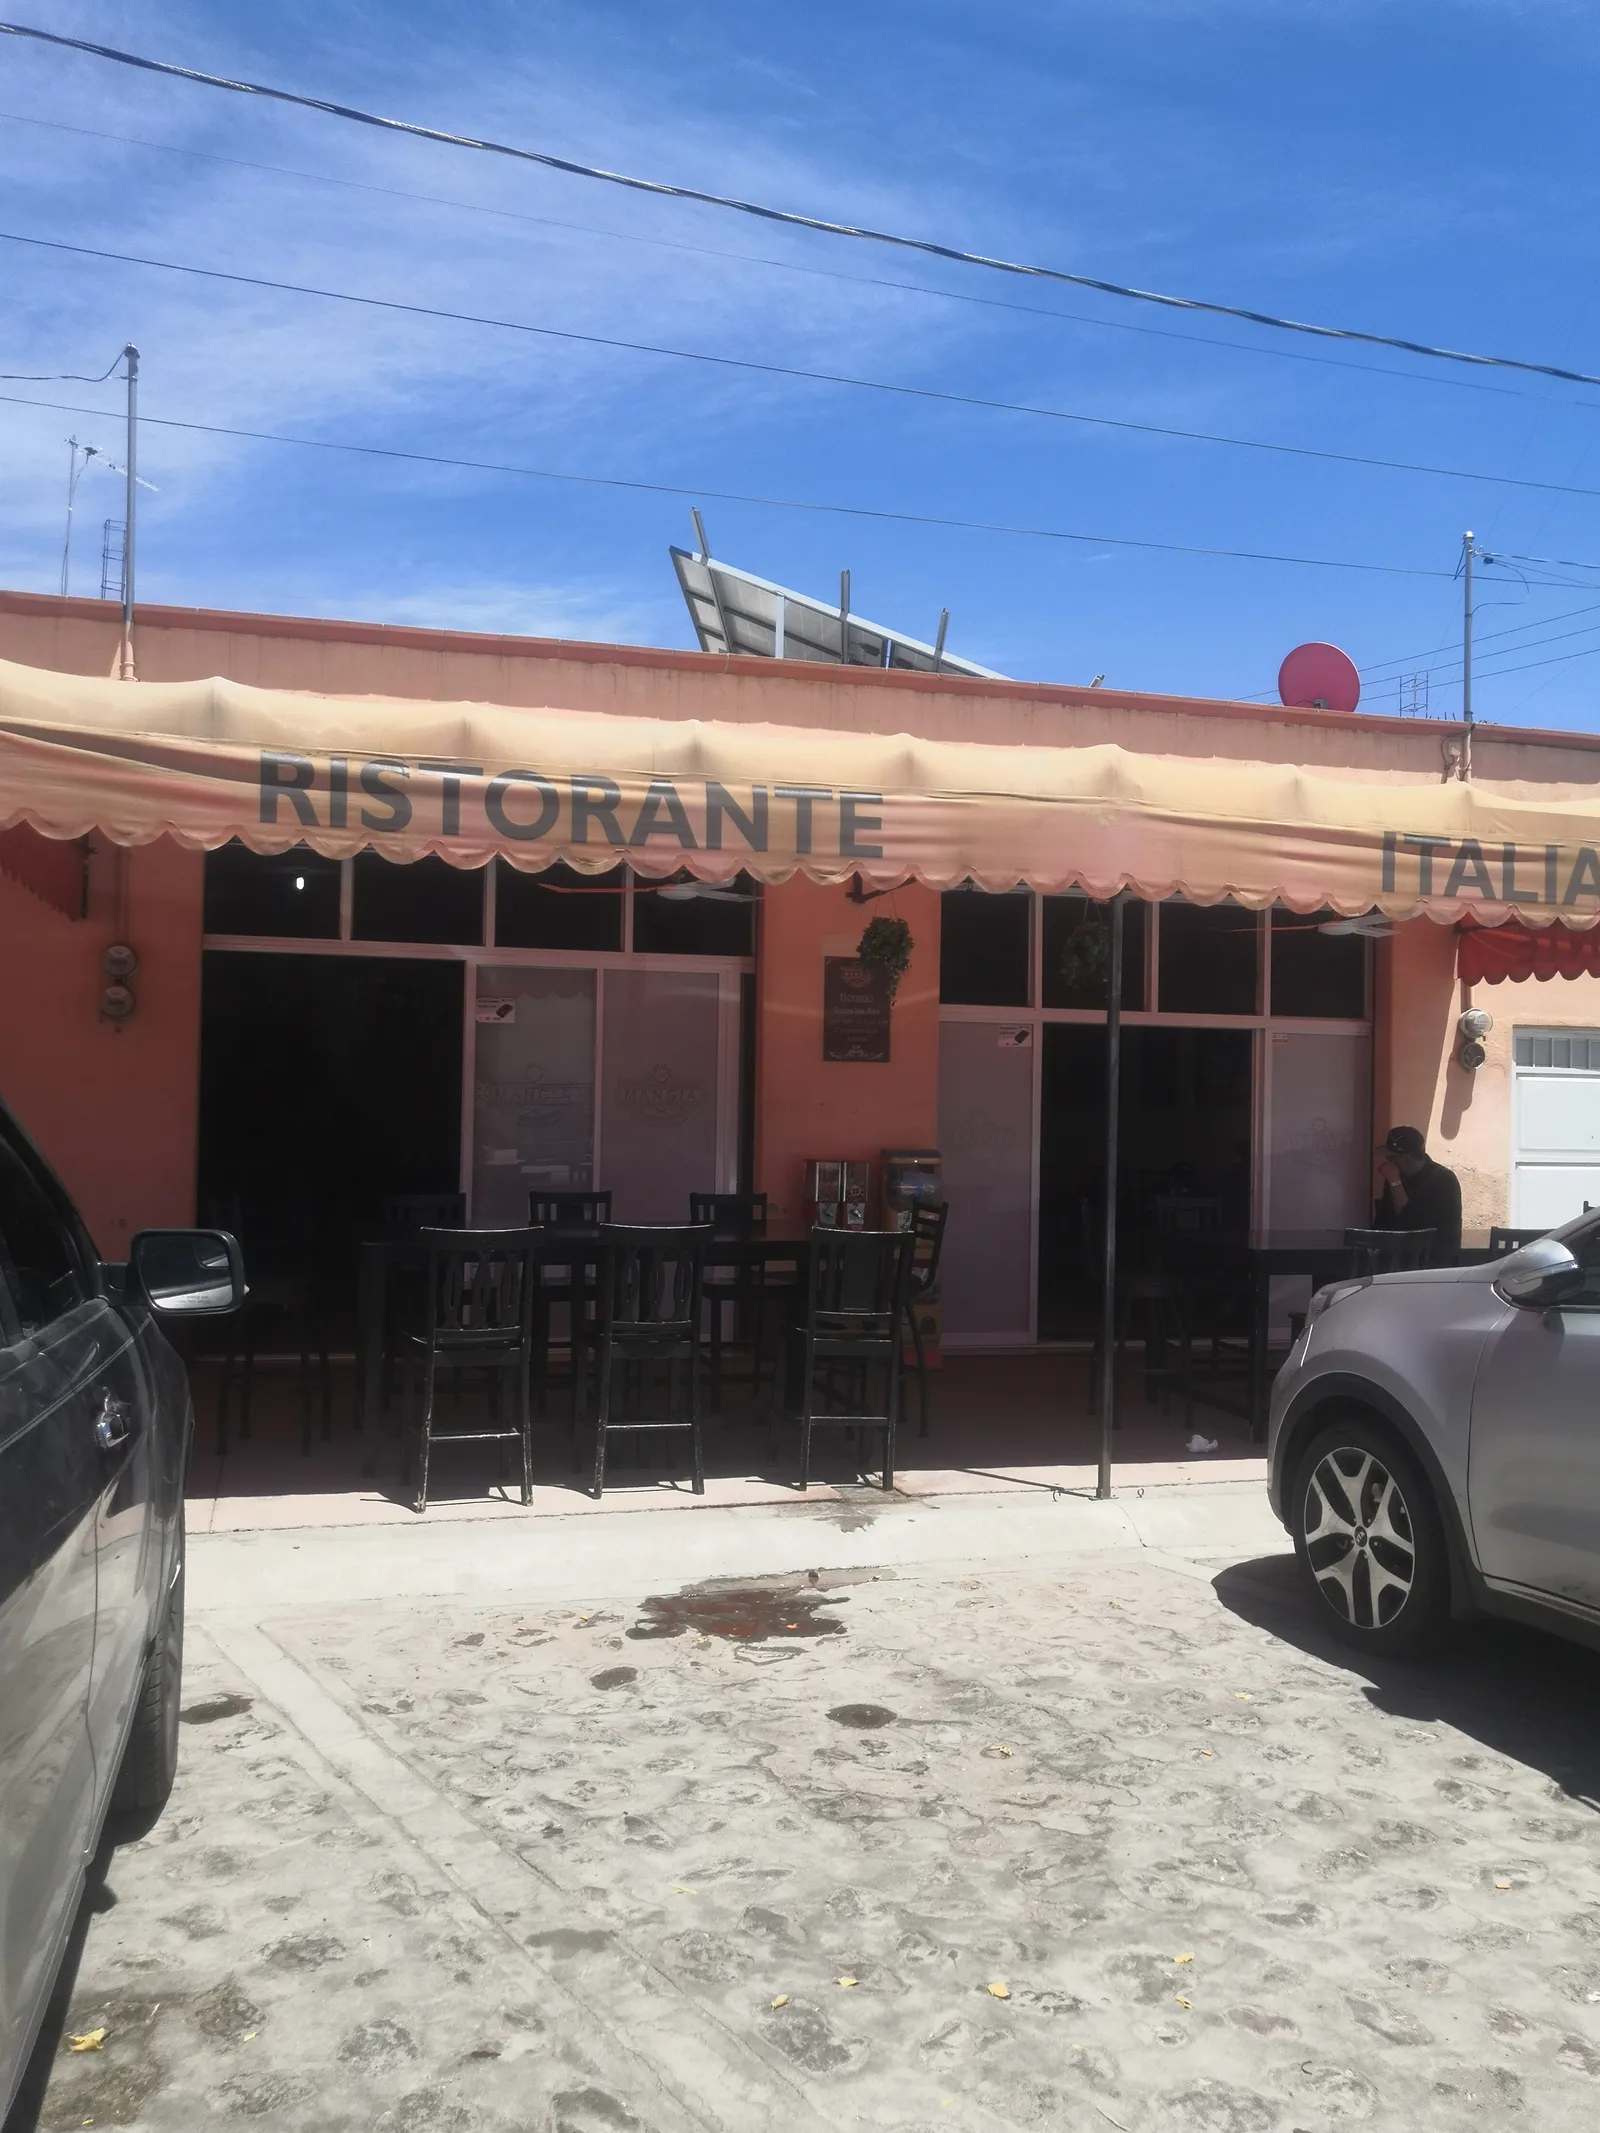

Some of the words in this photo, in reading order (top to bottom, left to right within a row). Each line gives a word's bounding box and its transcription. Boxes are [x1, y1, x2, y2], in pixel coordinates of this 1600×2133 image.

[260, 750, 884, 858] RISTORANTE
[1382, 831, 1600, 905] ITALIA
[625, 1089, 697, 1101] MANGIA
